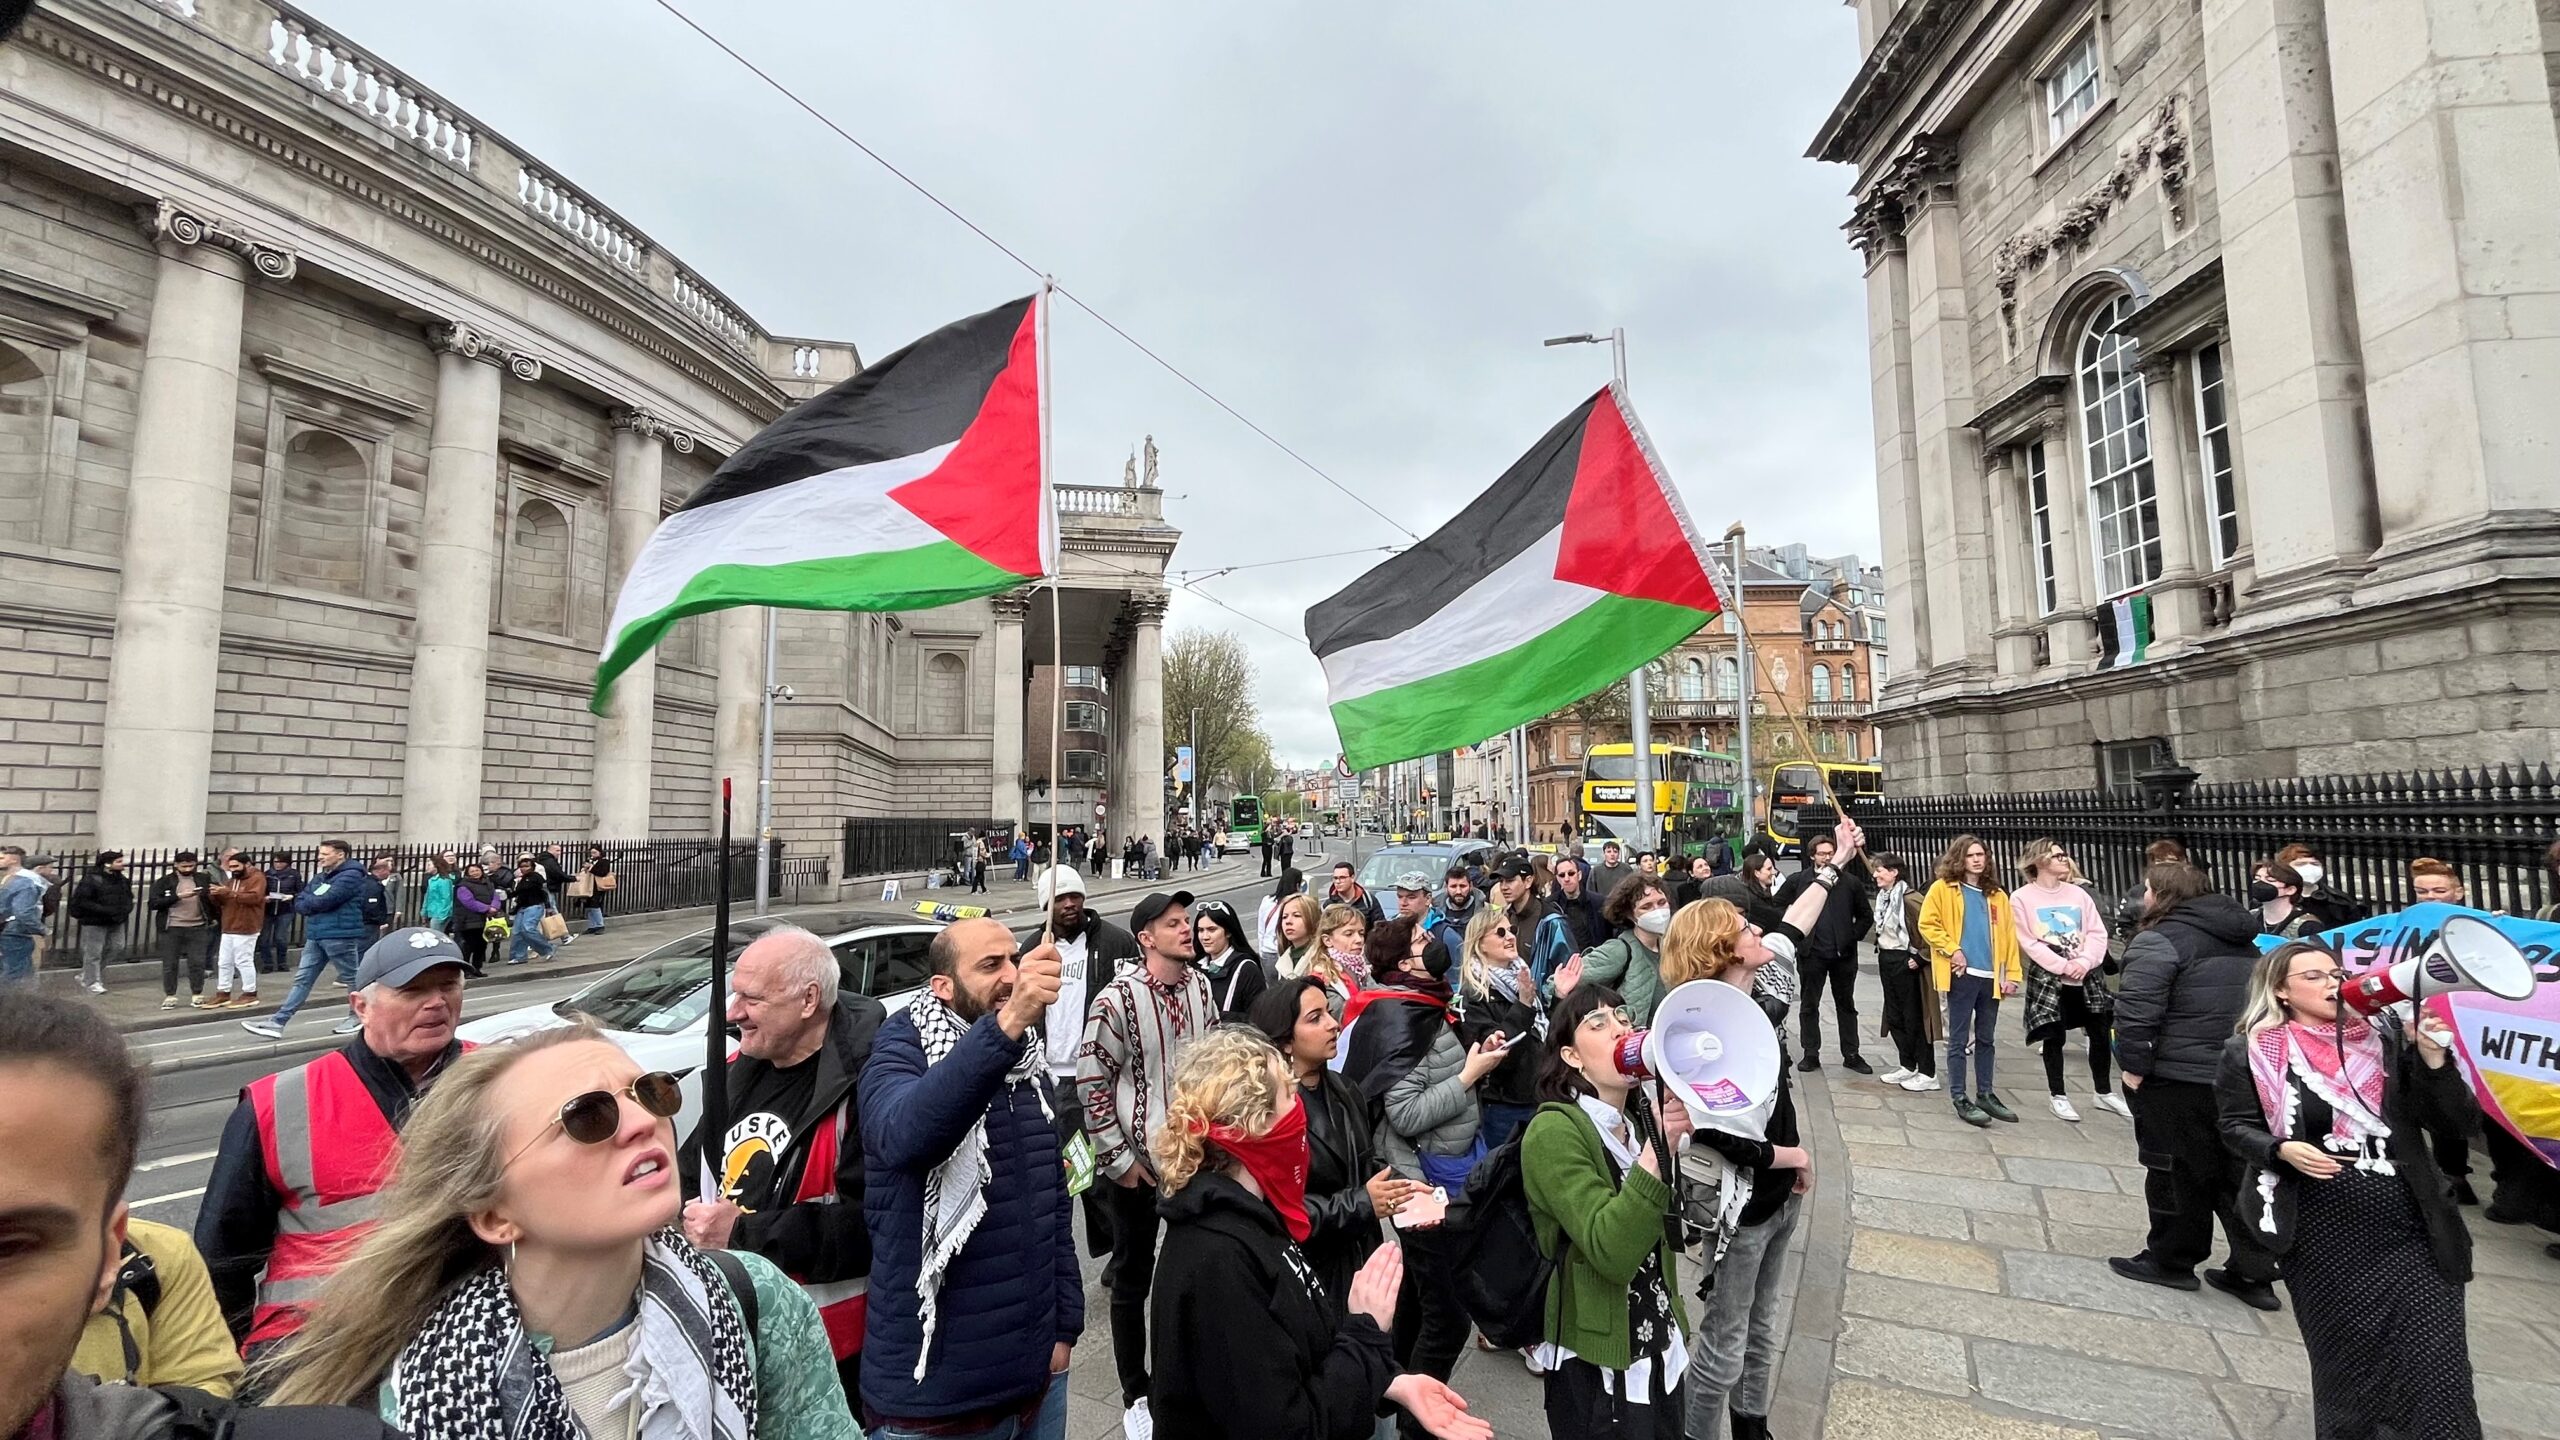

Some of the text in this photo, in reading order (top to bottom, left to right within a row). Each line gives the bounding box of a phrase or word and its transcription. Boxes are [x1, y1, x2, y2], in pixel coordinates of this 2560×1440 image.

[1410, 833, 1427, 841] TAXI
[935, 903, 958, 915] TAXI
[1062, 959, 1085, 980] IEGO
[2481, 1025, 2560, 1070] WITH
